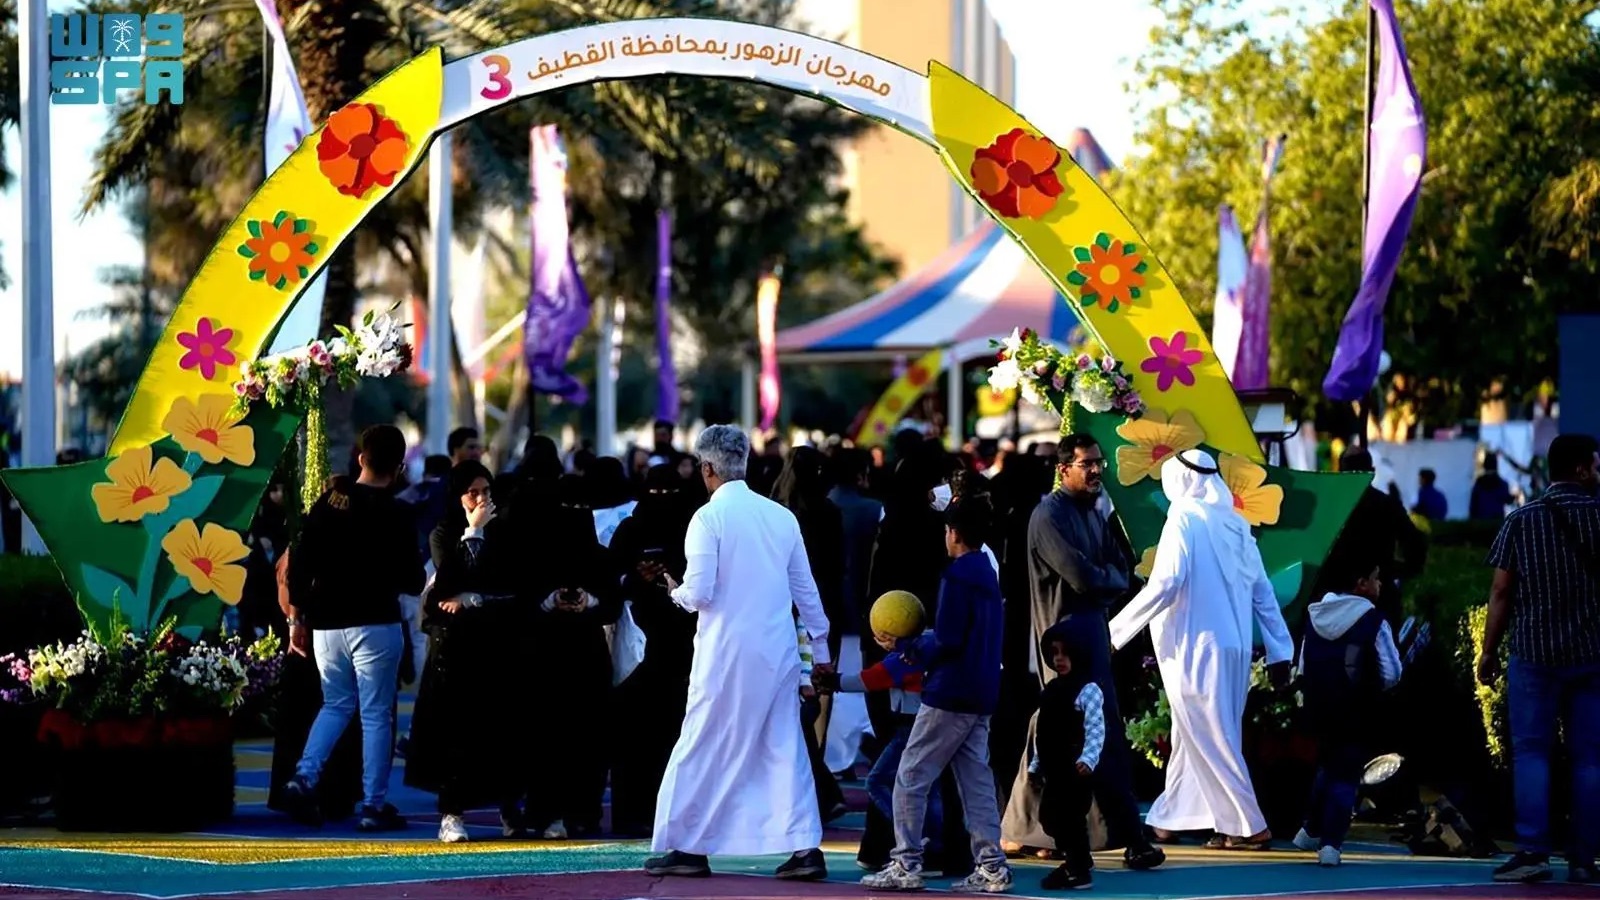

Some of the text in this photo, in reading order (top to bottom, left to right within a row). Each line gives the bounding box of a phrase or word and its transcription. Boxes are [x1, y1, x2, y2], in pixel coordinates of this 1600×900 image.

[480, 34, 891, 100] مهرجان الزهور بمحافظة القطيف 3
